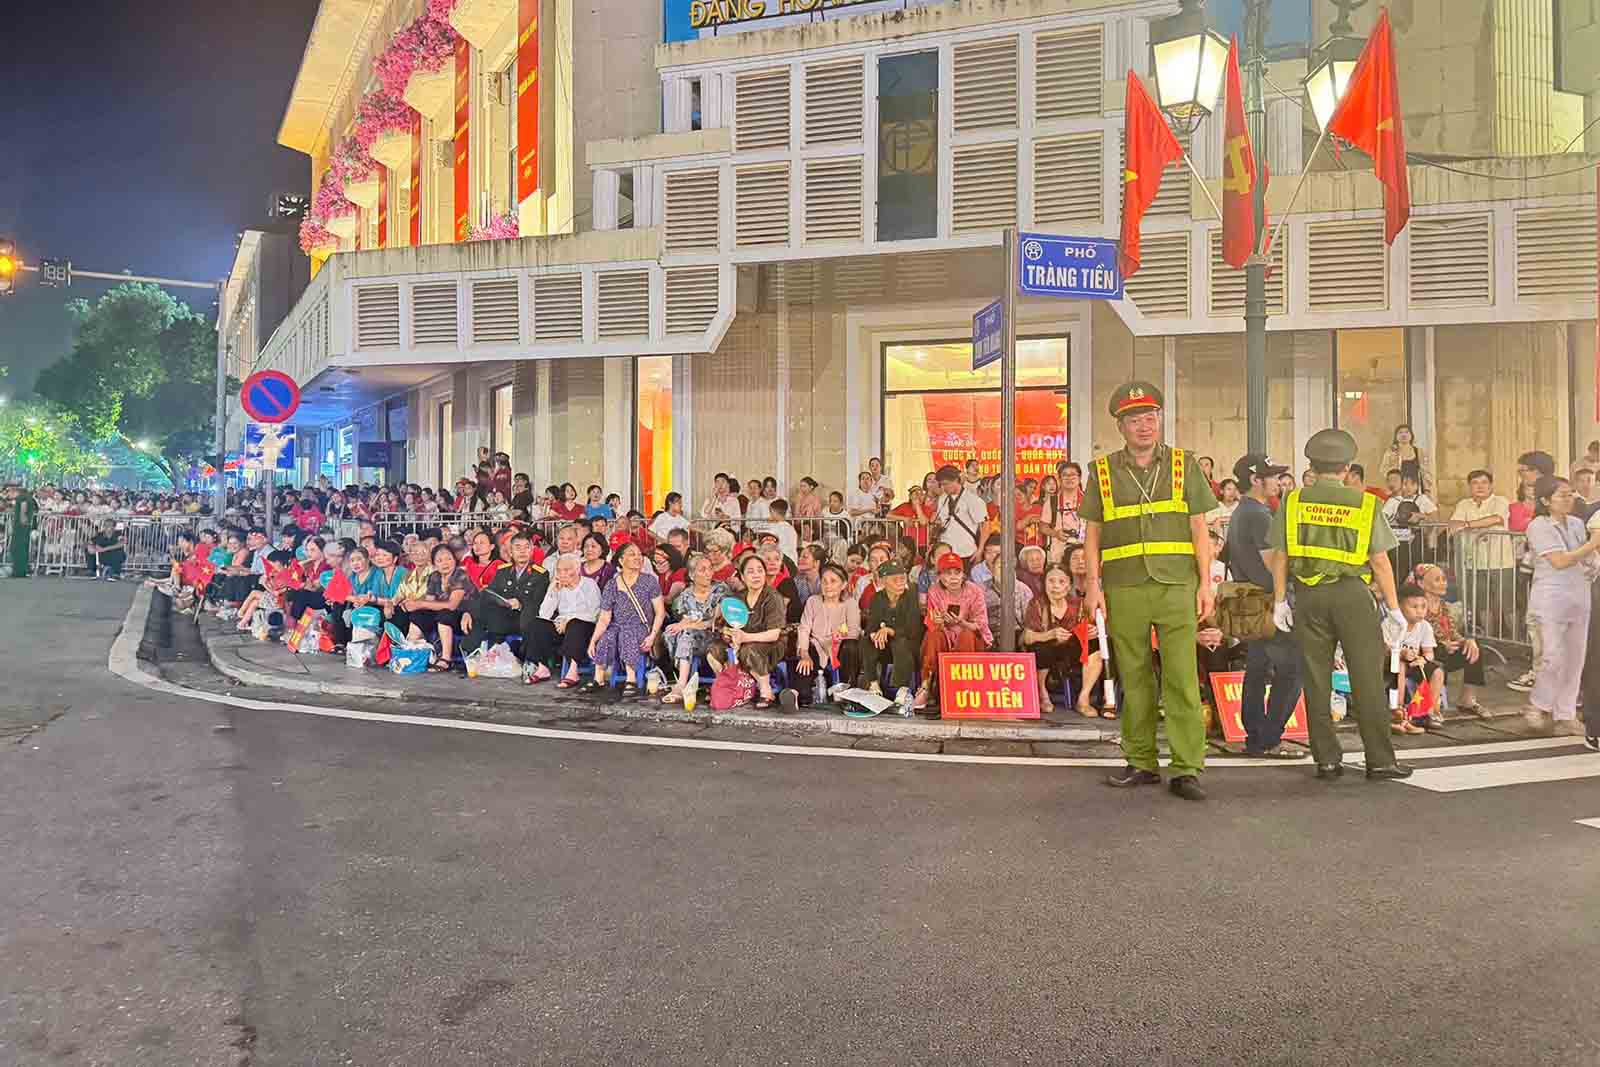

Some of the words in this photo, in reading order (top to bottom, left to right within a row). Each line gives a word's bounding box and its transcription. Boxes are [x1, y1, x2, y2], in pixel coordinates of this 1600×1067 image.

[1065, 245, 1097, 258] PHỐ
[1026, 261, 1077, 288] TRÀNG
[1081, 264, 1114, 290] TIỀN
[950, 663, 984, 681] KHU
[989, 662, 1025, 685] VỰC
[955, 688, 981, 708] ƯU
[986, 687, 1024, 708] TIÊN
